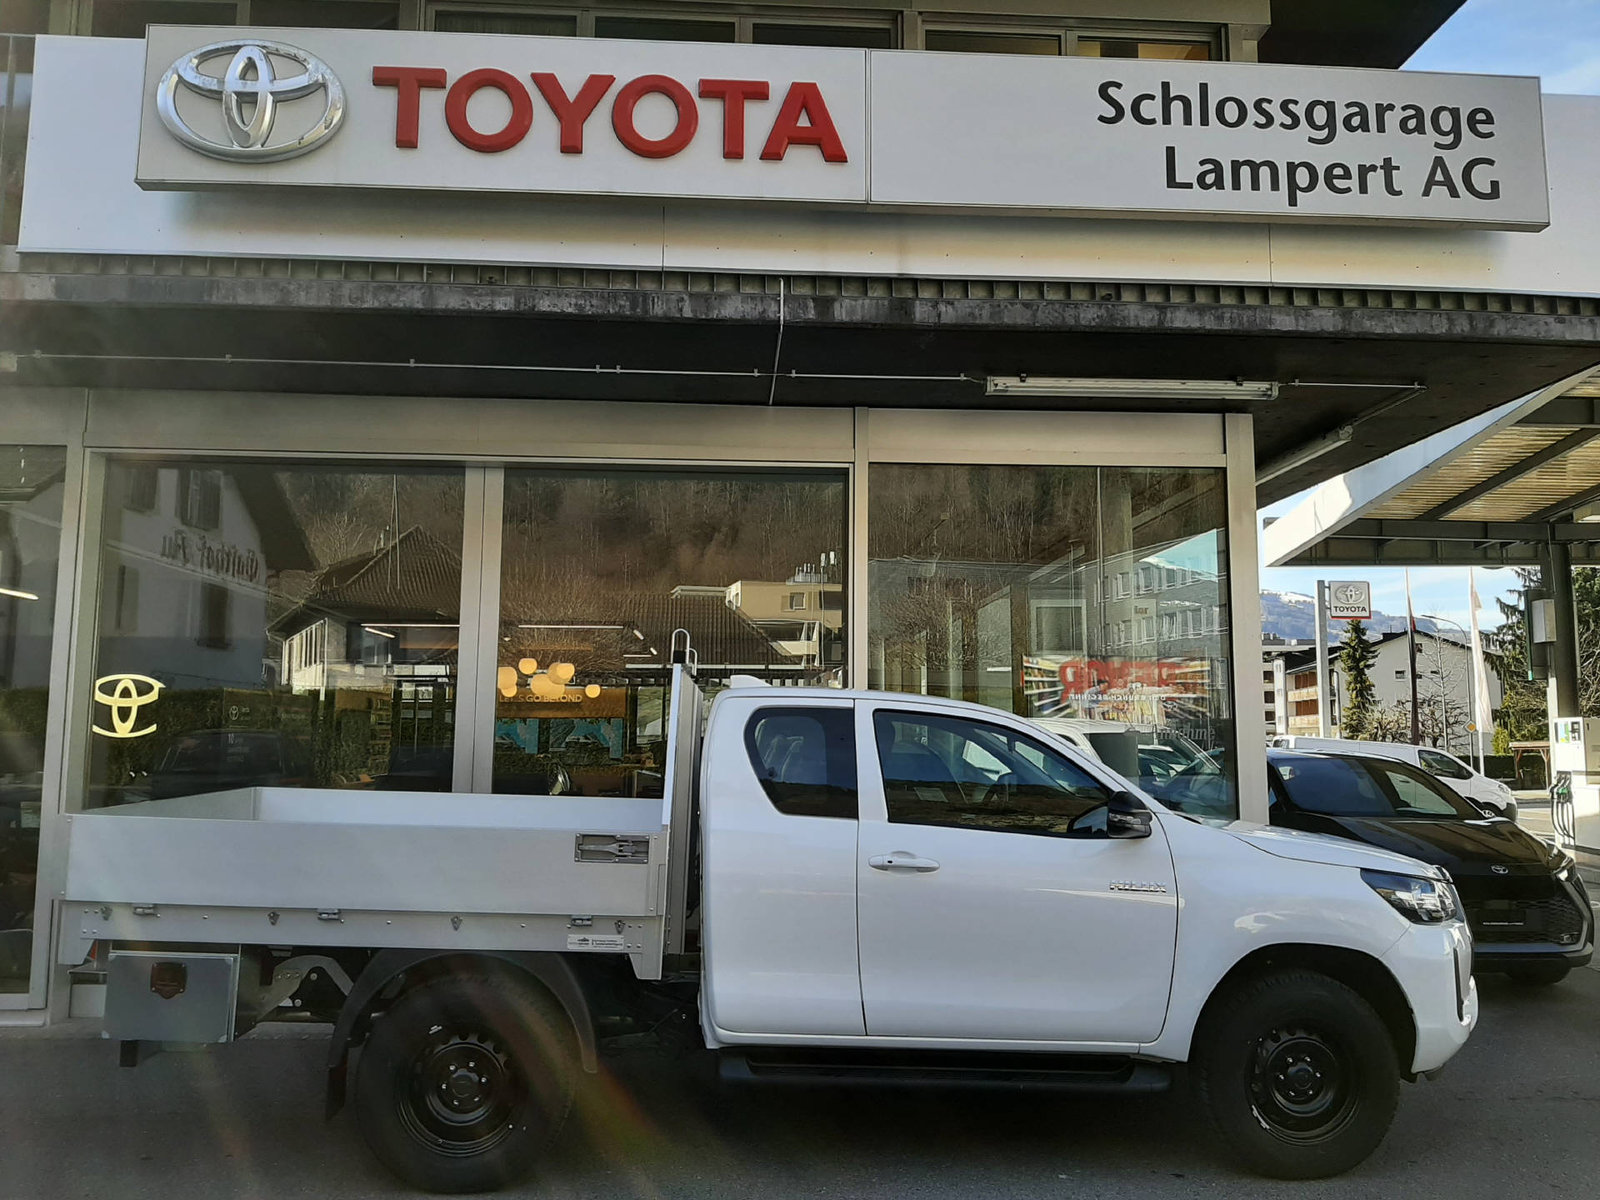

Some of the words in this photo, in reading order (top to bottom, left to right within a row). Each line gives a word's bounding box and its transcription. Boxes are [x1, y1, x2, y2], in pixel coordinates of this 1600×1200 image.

[372, 65, 847, 163] TOYOTA
[1096, 79, 1496, 150] Schlossgarage
[1165, 146, 1402, 207] Lampert
[1421, 155, 1501, 201] AG
[1109, 880, 1167, 893] HILUX
